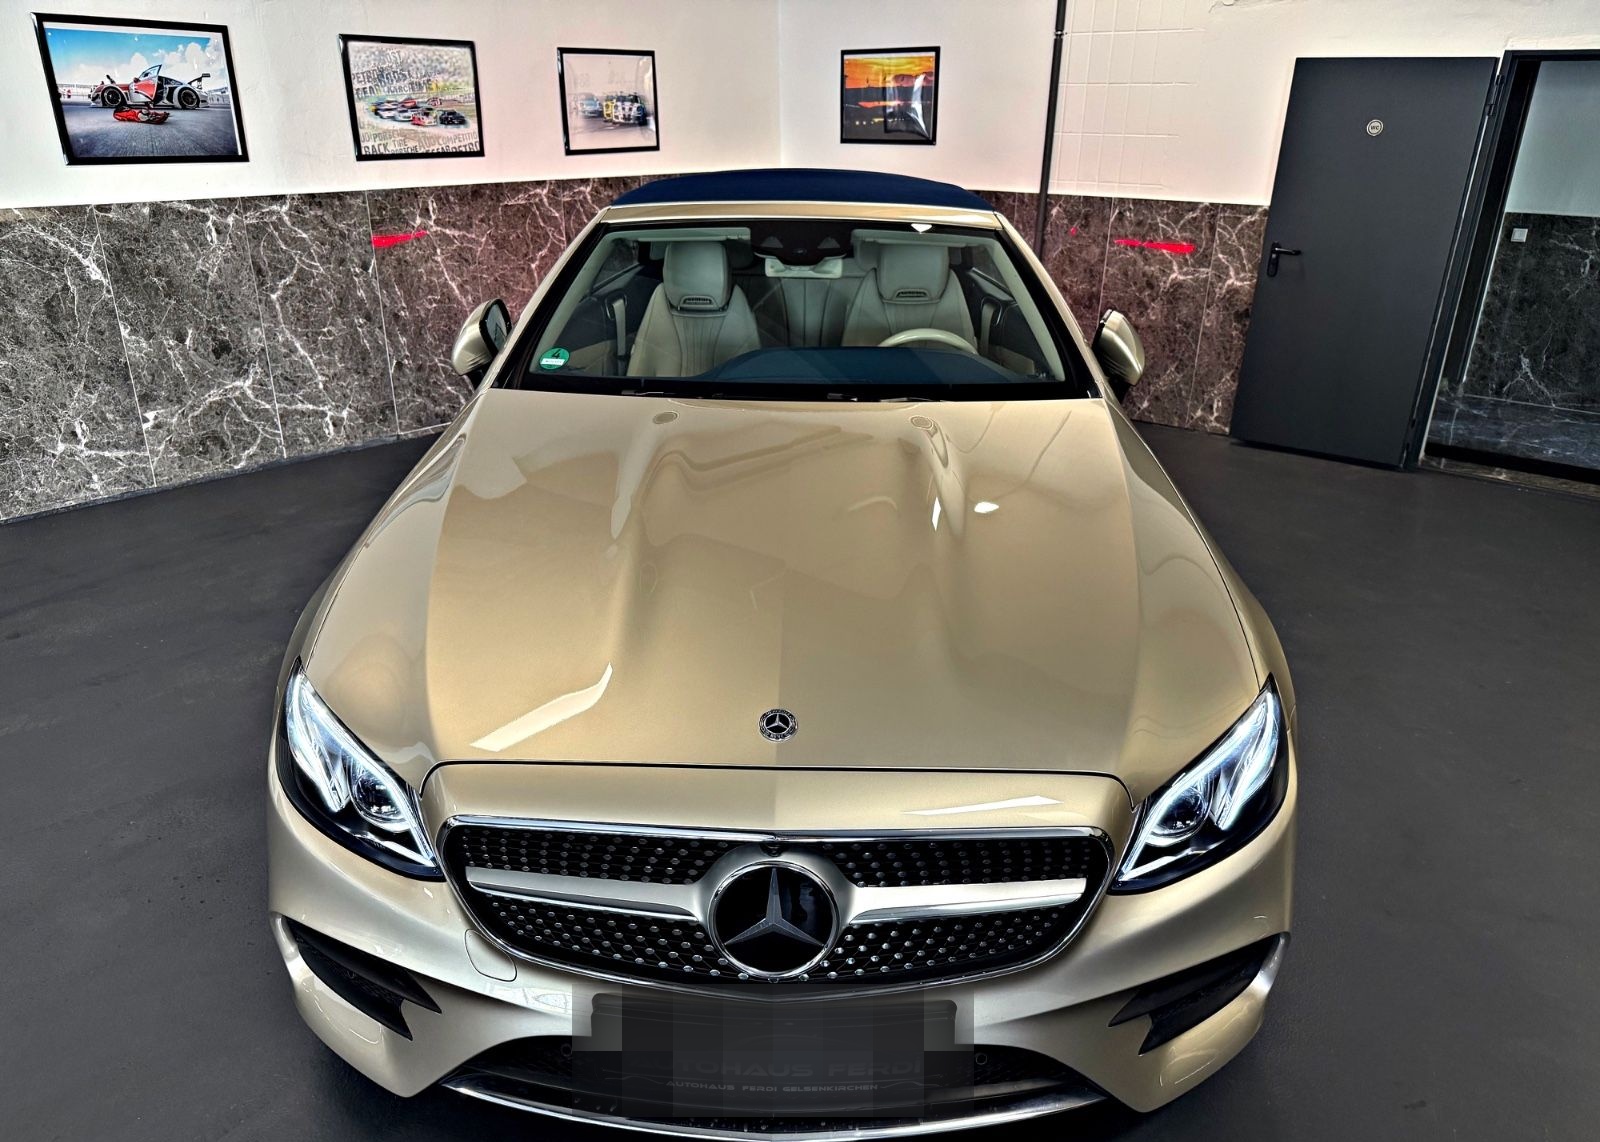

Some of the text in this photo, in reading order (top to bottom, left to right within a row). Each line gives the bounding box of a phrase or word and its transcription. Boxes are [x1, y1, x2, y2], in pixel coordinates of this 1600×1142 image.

[551, 349, 561, 359] 4
[666, 1080, 735, 1091] AUTOHAUS
[782, 1083, 878, 1092] GELSENKIRCHEN
